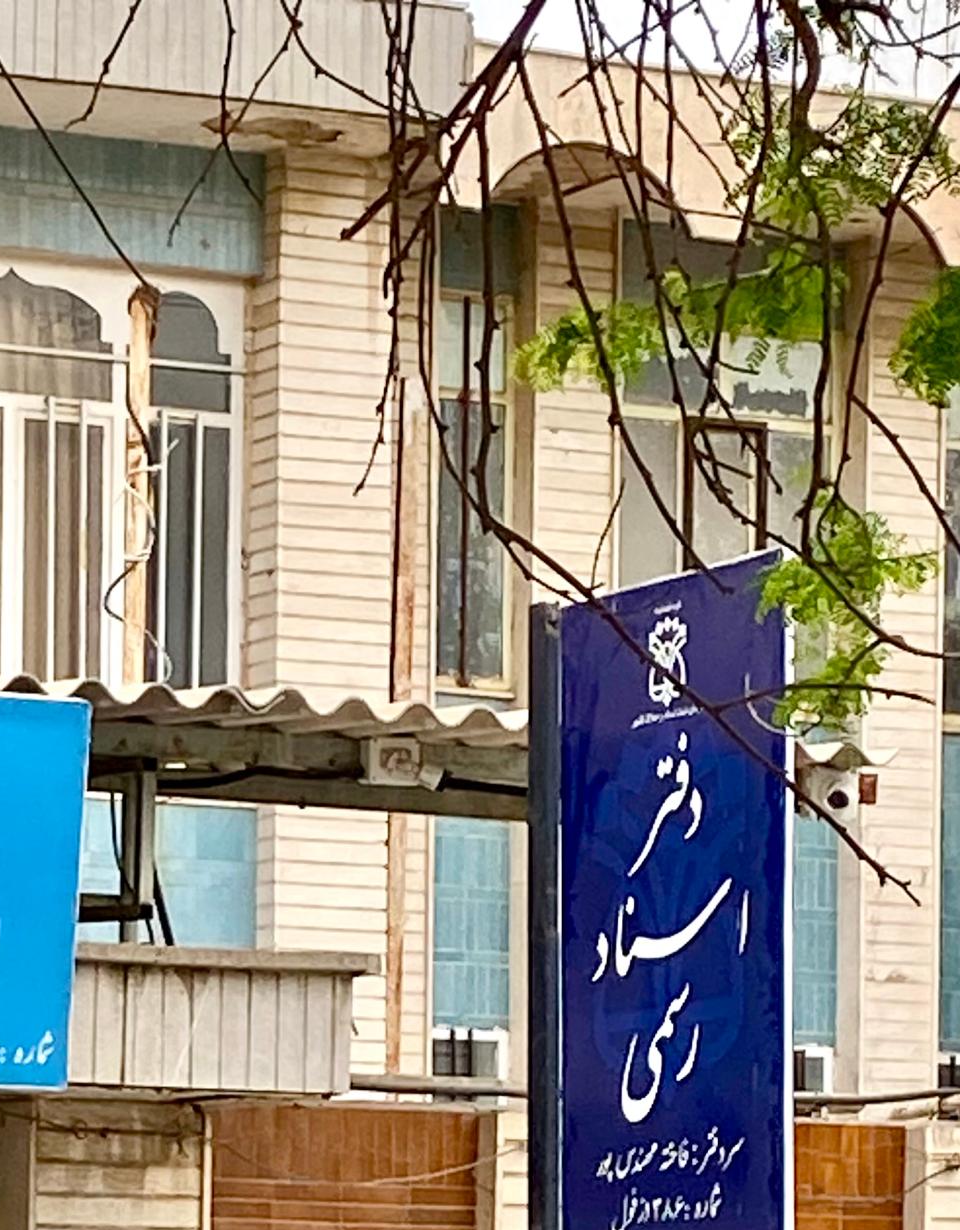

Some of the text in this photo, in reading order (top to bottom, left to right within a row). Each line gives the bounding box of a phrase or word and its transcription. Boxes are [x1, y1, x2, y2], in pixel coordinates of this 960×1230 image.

[627, 731, 703, 877] دفتر
[591, 877, 749, 982] اسناد
[621, 982, 700, 1121] رسمی
